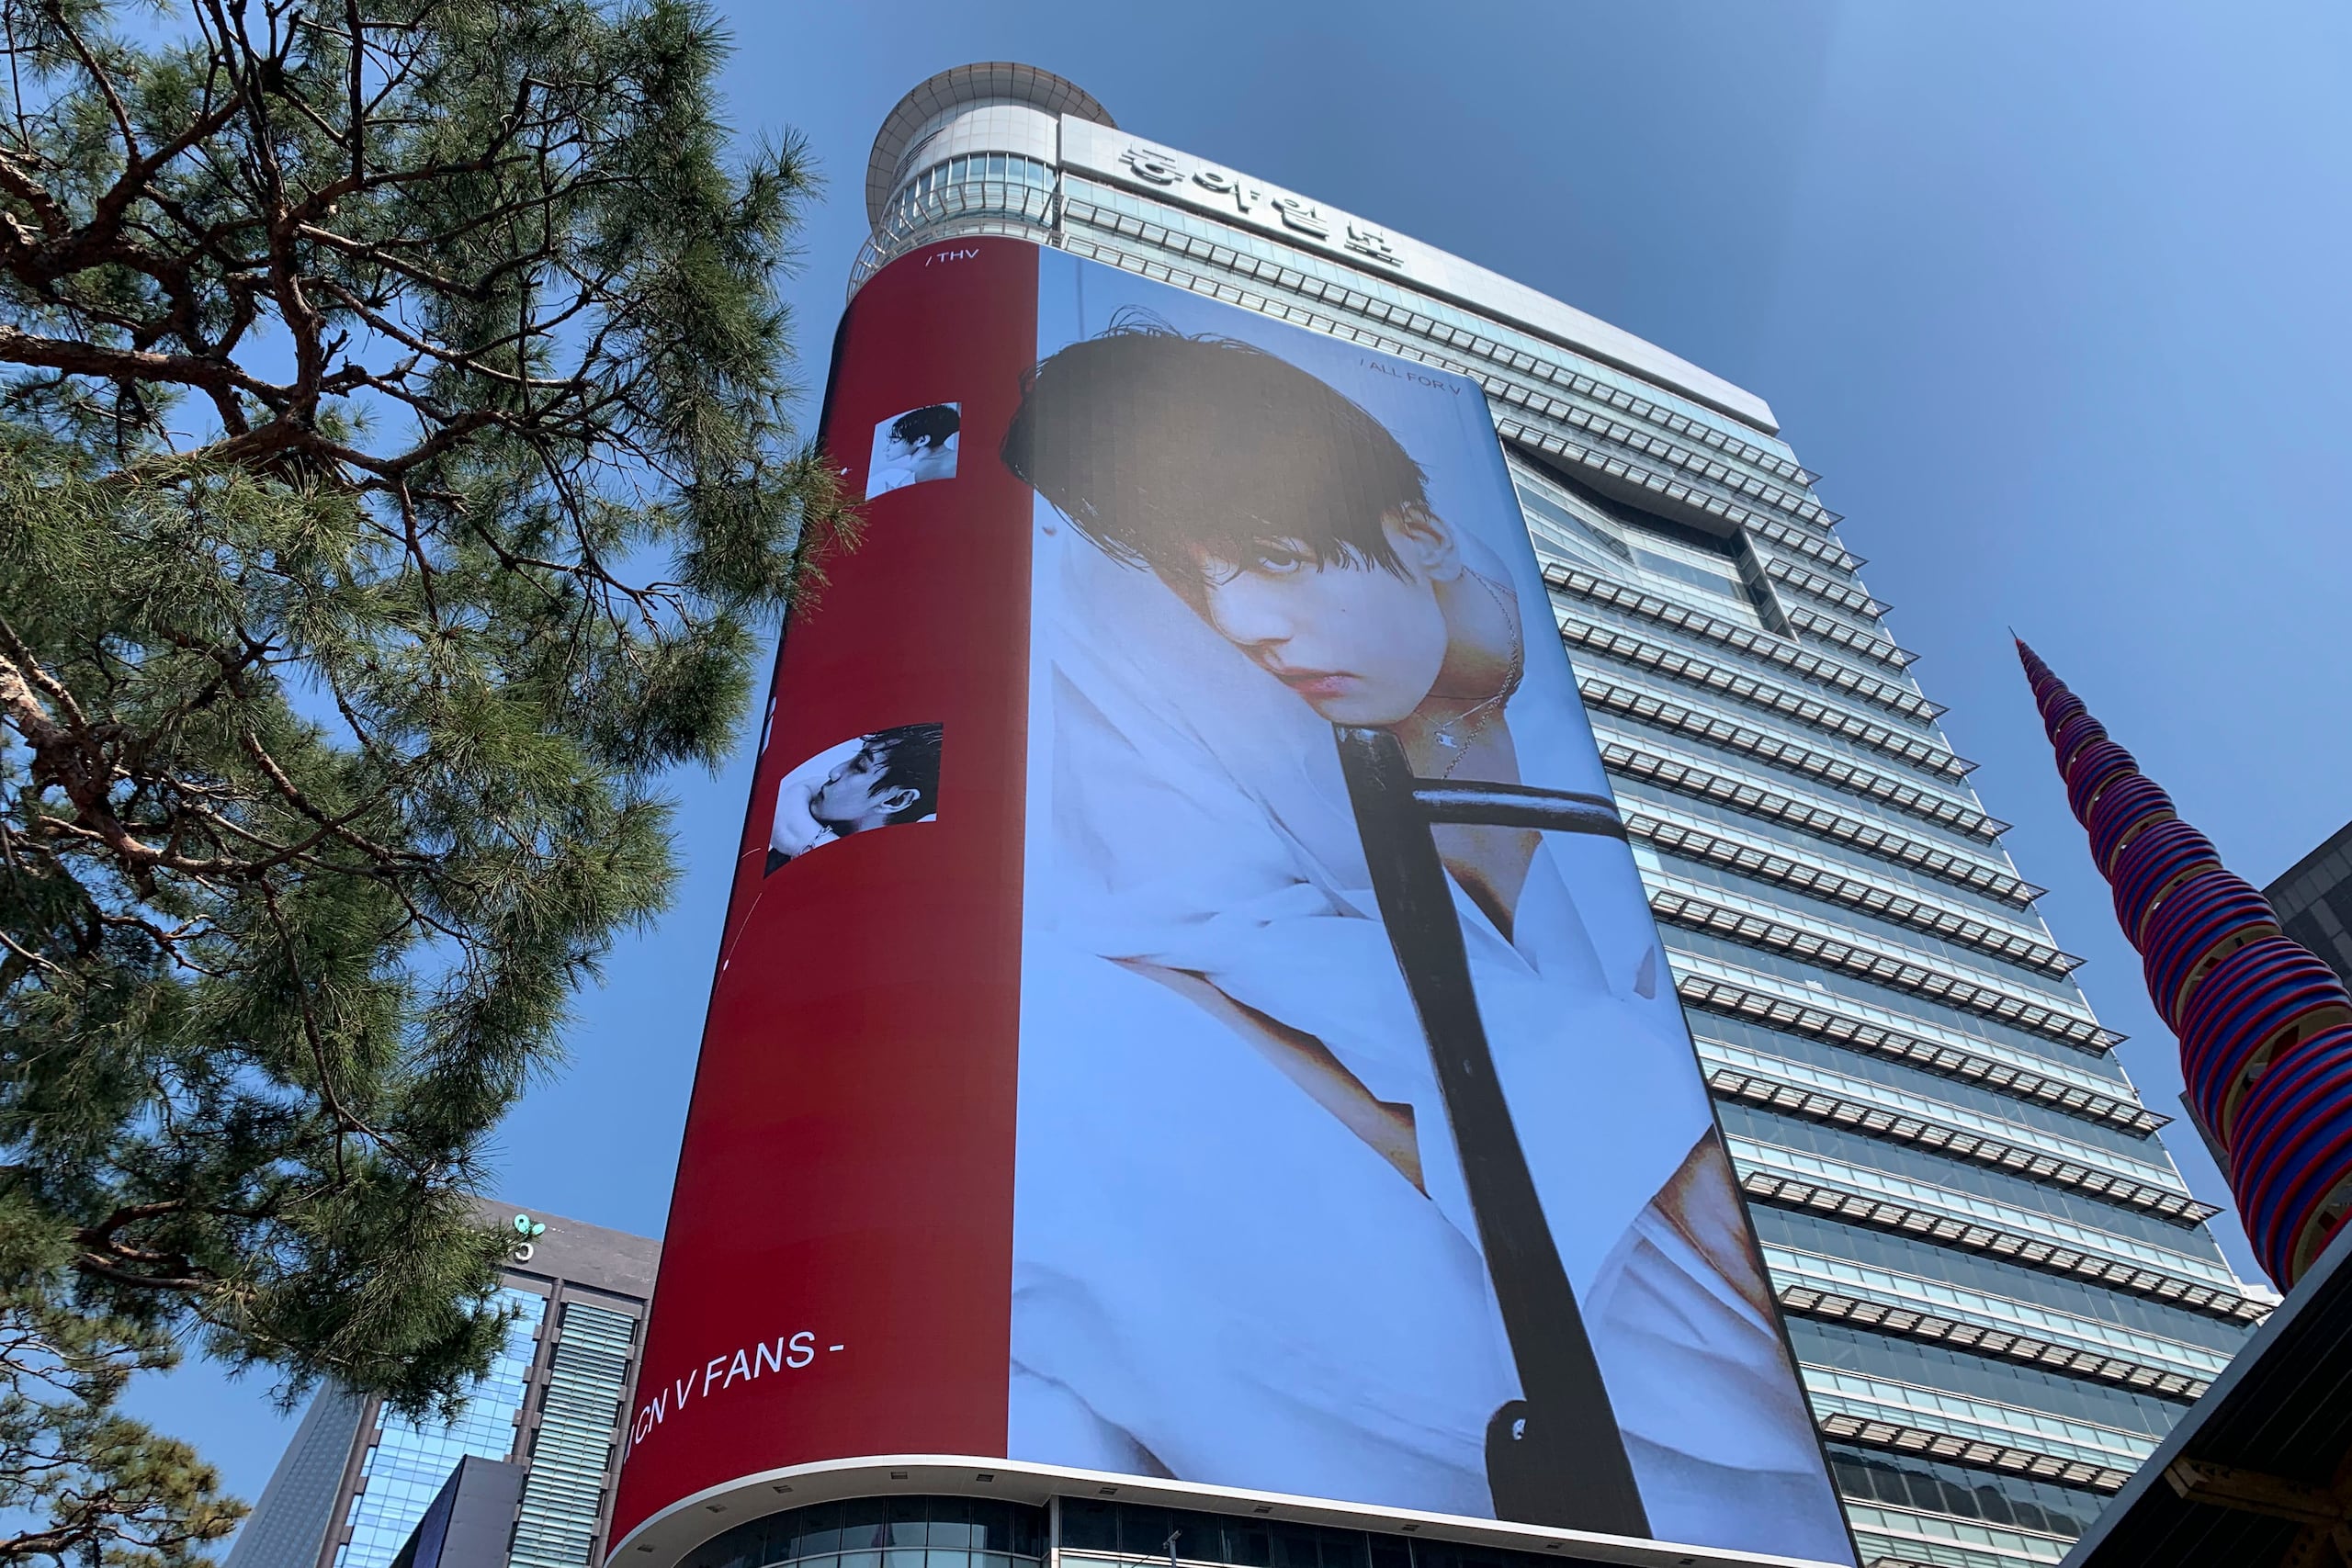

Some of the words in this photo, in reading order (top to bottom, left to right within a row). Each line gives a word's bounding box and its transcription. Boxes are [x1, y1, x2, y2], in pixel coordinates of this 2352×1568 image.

[1118, 142, 1405, 268] 동아일보
[936, 248, 979, 263] THV
[1369, 361, 1402, 378] ALL
[1407, 372, 1446, 391] FOR
[1449, 384, 1461, 395] V
[676, 1369, 698, 1410] V
[703, 1331, 816, 1398] FANS
